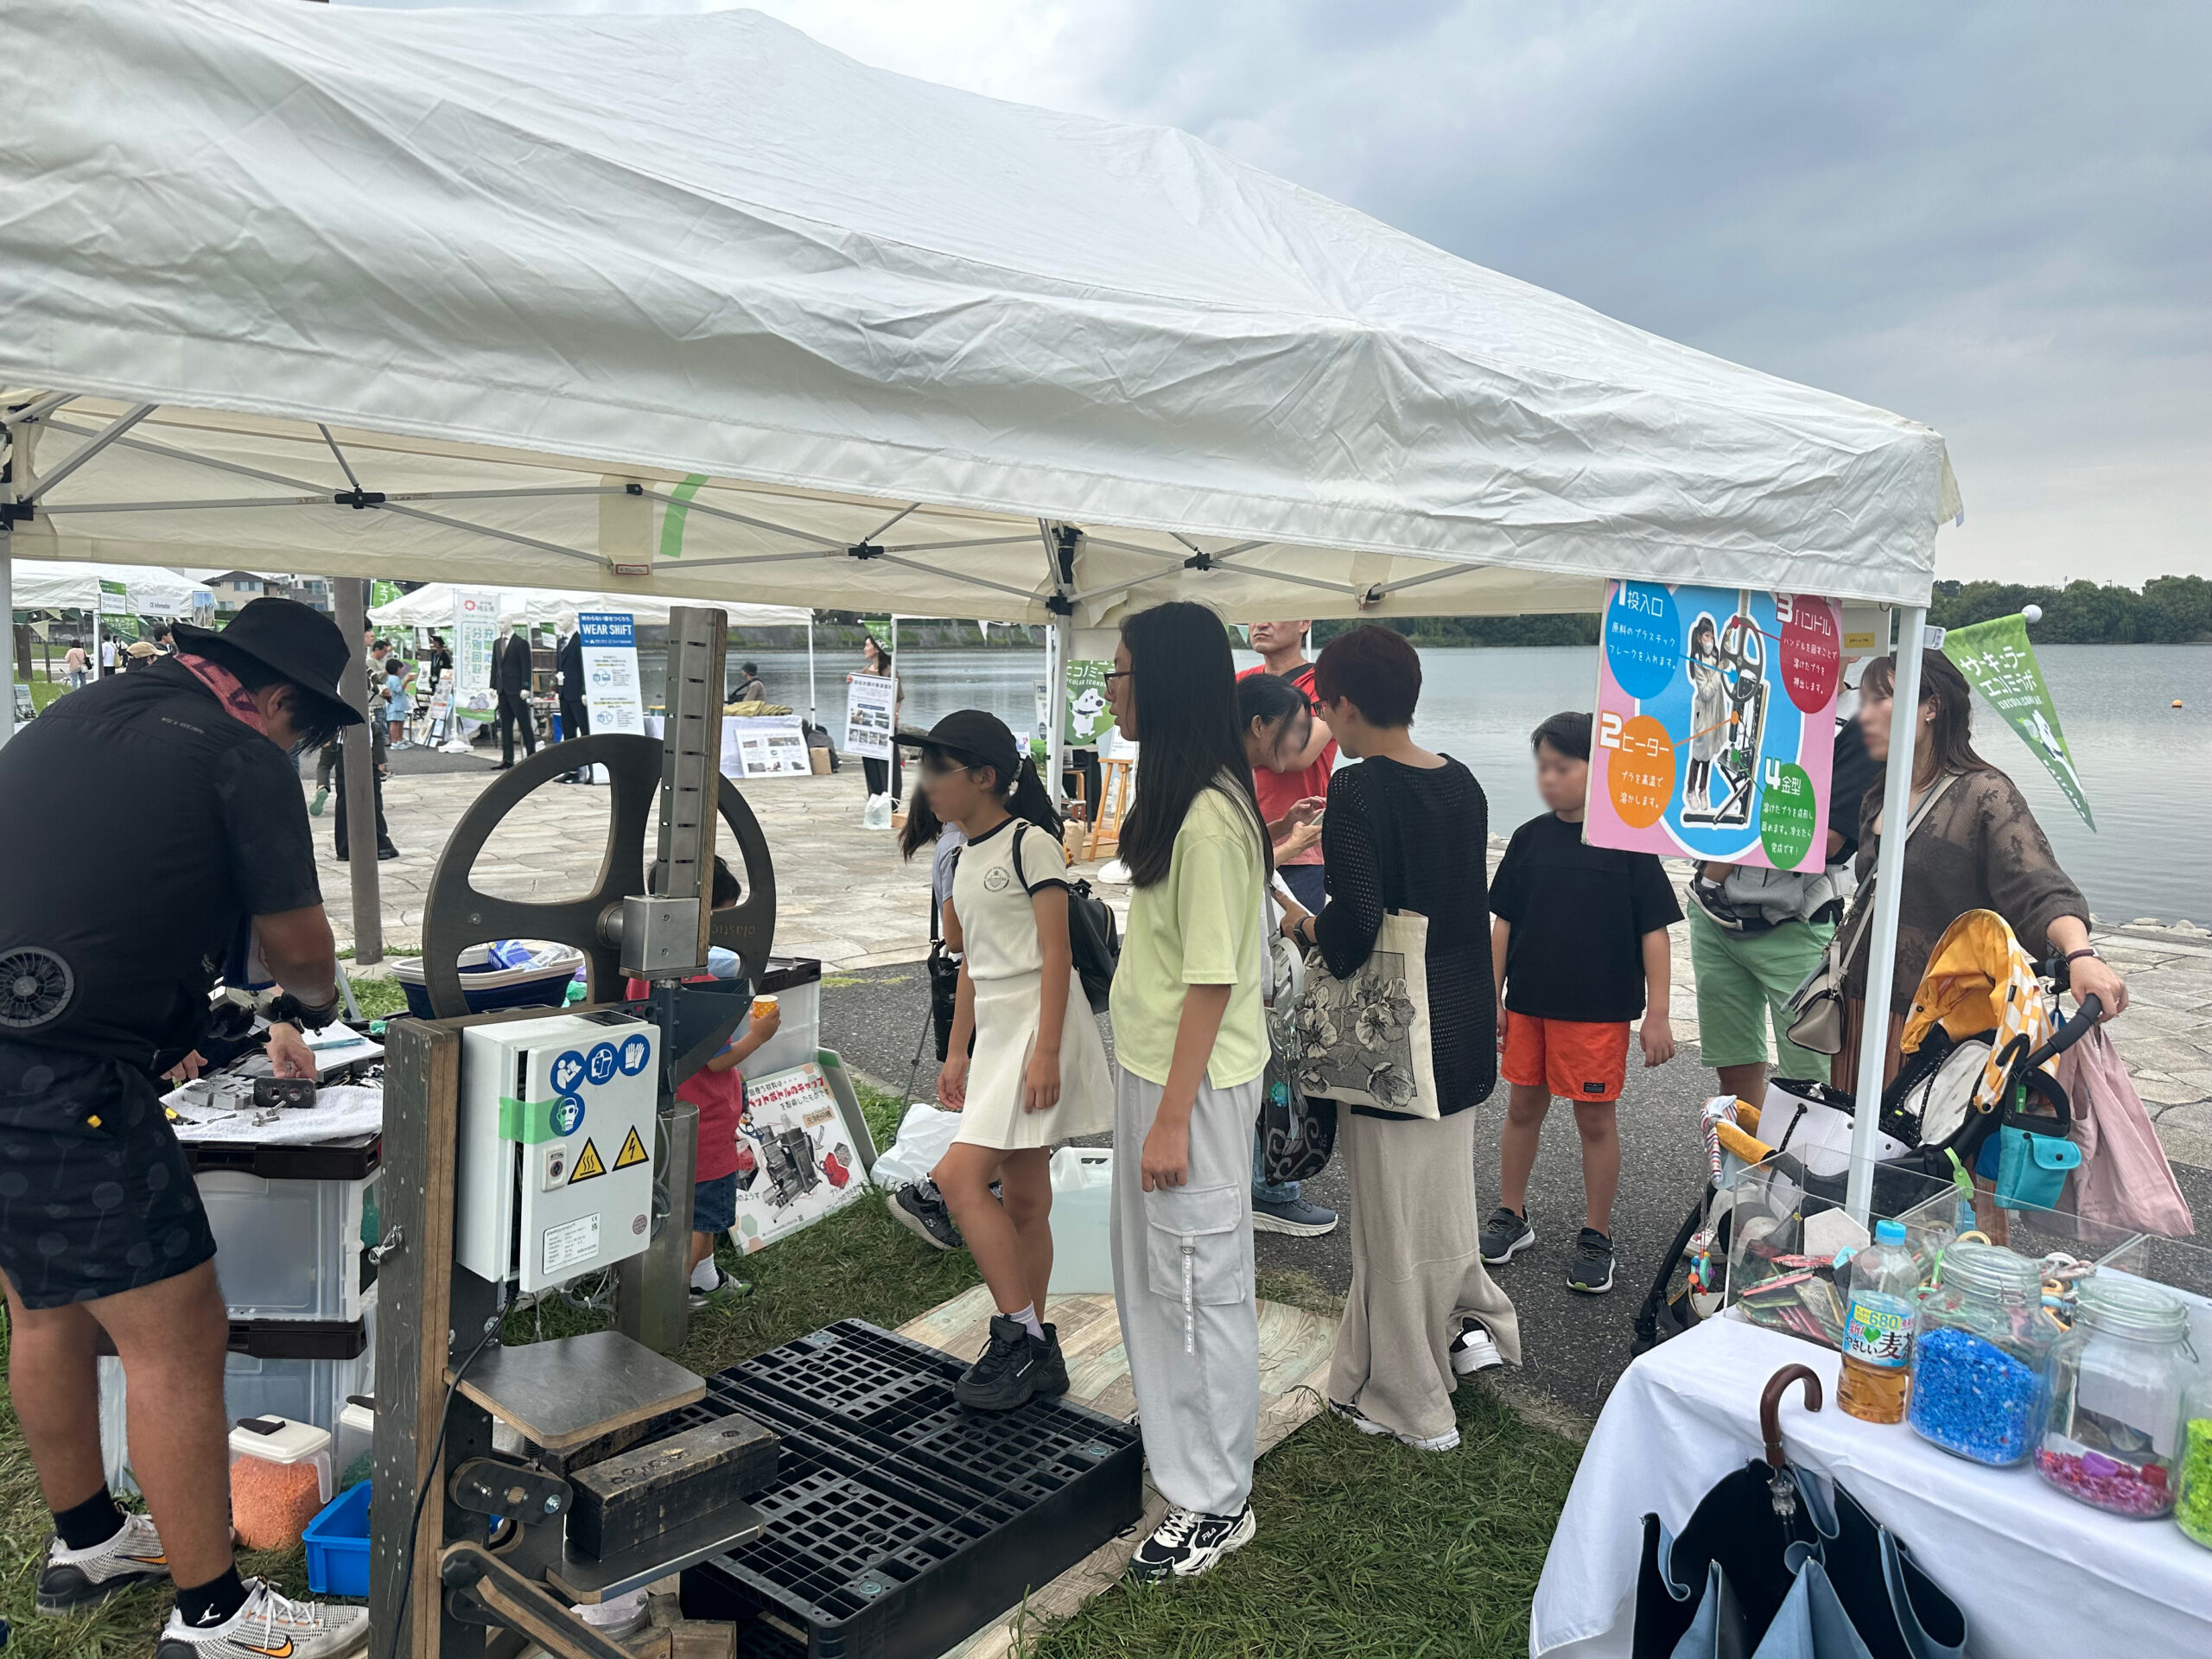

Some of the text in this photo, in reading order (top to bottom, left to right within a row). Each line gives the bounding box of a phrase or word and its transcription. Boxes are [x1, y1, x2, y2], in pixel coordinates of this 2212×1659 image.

[1627, 590, 1663, 618] 投入口
[1777, 593, 1831, 637] 3 ハンドル
[582, 624, 608, 635] WEAR
[1611, 621, 1675, 647] 原料のプラスチック
[472, 627, 482, 684] 分別回収に
[1609, 644, 1676, 670] フレークを入れます。
[1784, 639, 1838, 660] ハンドルを回すことで
[1794, 657, 1825, 677] 溶けたプラを
[1794, 677, 1824, 695] 押出します。
[1599, 712, 1669, 757] 2 ヒーター
[1622, 771, 1663, 787] プラを高温で
[1764, 758, 1802, 796] 4 金型
[1620, 791, 1659, 809] 溶かします。
[1763, 802, 1813, 820] 溶けたプラを成形し
[1761, 821, 1812, 839] 固めます。冷えたら
[1869, 1313, 1898, 1329] 680
[1201, 1527, 1217, 1541] FILA
